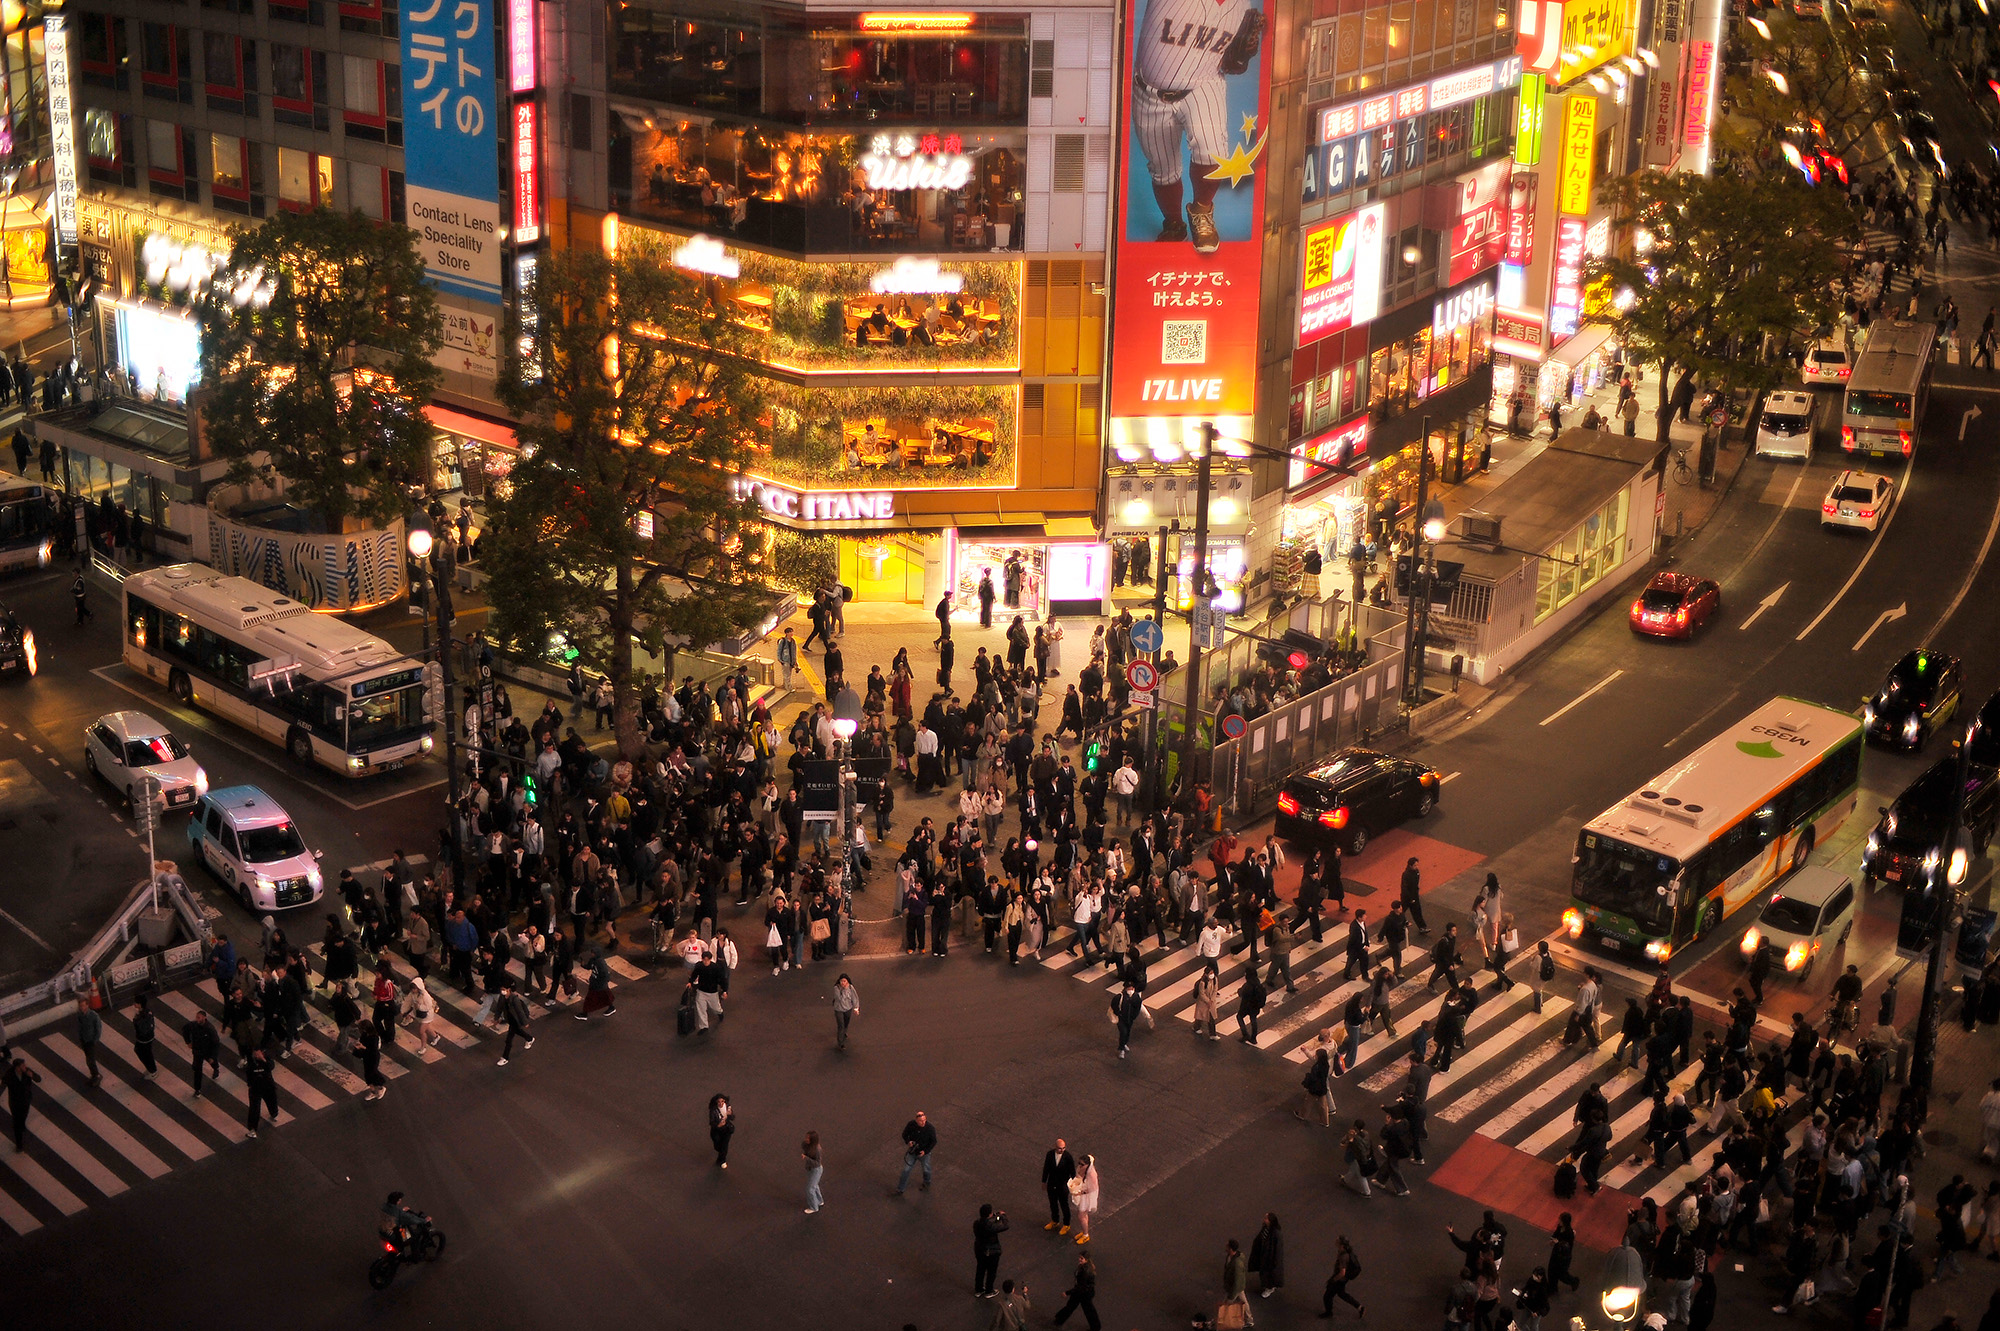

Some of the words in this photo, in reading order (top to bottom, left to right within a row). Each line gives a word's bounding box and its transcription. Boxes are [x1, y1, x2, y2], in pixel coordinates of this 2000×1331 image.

[1160, 18, 1234, 55] LIVE
[50, 58, 67, 89] 内科
[516, 75, 531, 88] 4F
[1326, 108, 1355, 137] 薄毛
[1363, 97, 1391, 127] 抜毛
[1398, 87, 1425, 117] 発毛
[1497, 56, 1521, 88] 4F
[52, 94, 73, 157] 産婦人科
[1520, 103, 1532, 132] レイク
[518, 105, 533, 172] 外貨両替
[872, 134, 962, 157] 渋谷焼肉
[1567, 99, 1593, 179] 処方せん
[1301, 135, 1370, 196] AGA
[58, 160, 77, 223] 心療内科
[1569, 183, 1582, 210] 3F
[412, 201, 459, 226] Contact
[463, 212, 494, 234] Lens
[1461, 205, 1499, 247] アコム
[1510, 212, 1525, 248] アコム
[424, 225, 483, 254] Speciality
[437, 250, 471, 271] Store
[1307, 234, 1331, 284] 薬
[1471, 249, 1485, 270] 3F
[1146, 271, 1232, 287] イチナナで、
[1153, 291, 1223, 308] 叶えよう。
[1303, 293, 1320, 308] DRUG
[1432, 282, 1488, 338] LUSH
[1142, 378, 1223, 401] 17LIVE
[1750, 724, 1811, 747] M383
